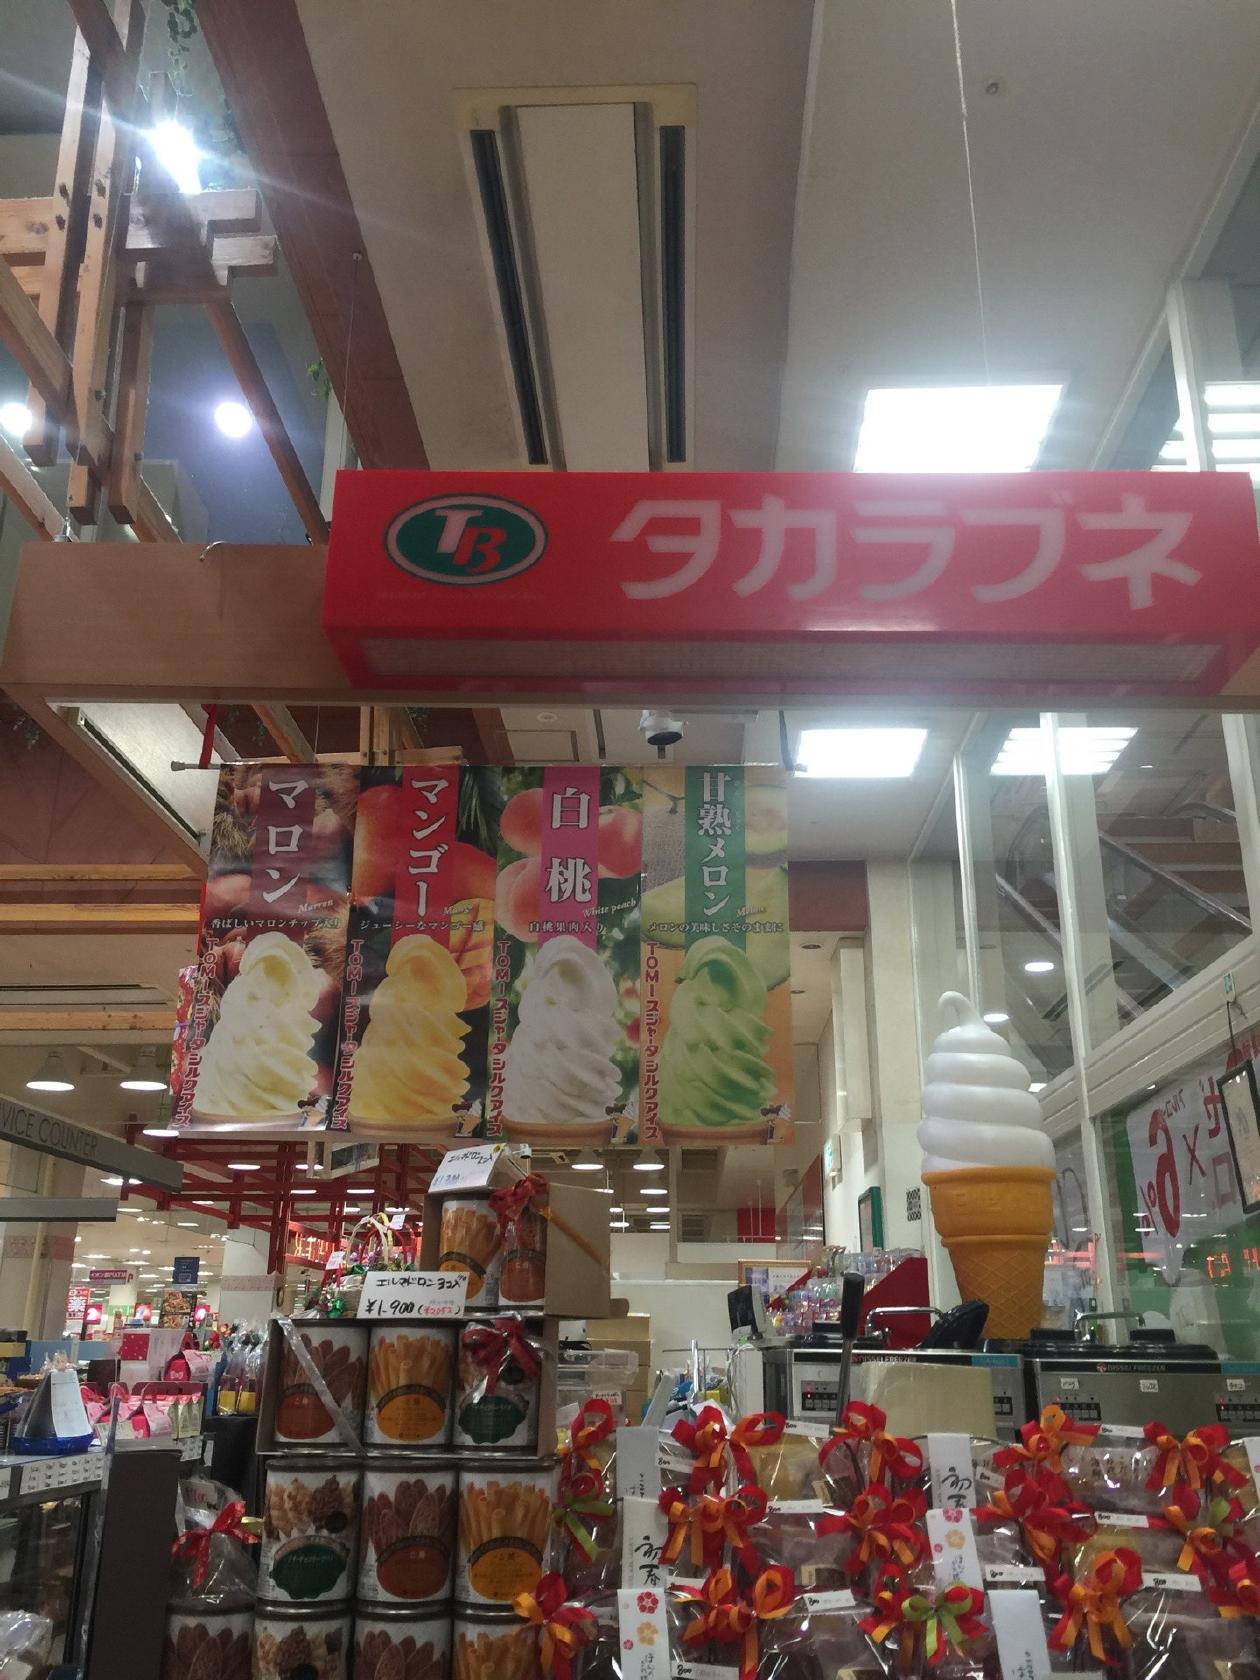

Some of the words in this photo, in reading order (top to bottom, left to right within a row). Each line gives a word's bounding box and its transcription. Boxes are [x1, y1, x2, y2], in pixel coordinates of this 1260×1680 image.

[609, 494, 1202, 611] タカラブネ
[261, 778, 309, 903] マロン
[408, 778, 450, 917] マンゴー
[545, 787, 593, 903] 白桃
[696, 771, 733, 917] 甘熟メロン
[648, 920, 785, 934] メロンの美味しさそのままに
[38, 1118, 98, 1159] COUNTER
